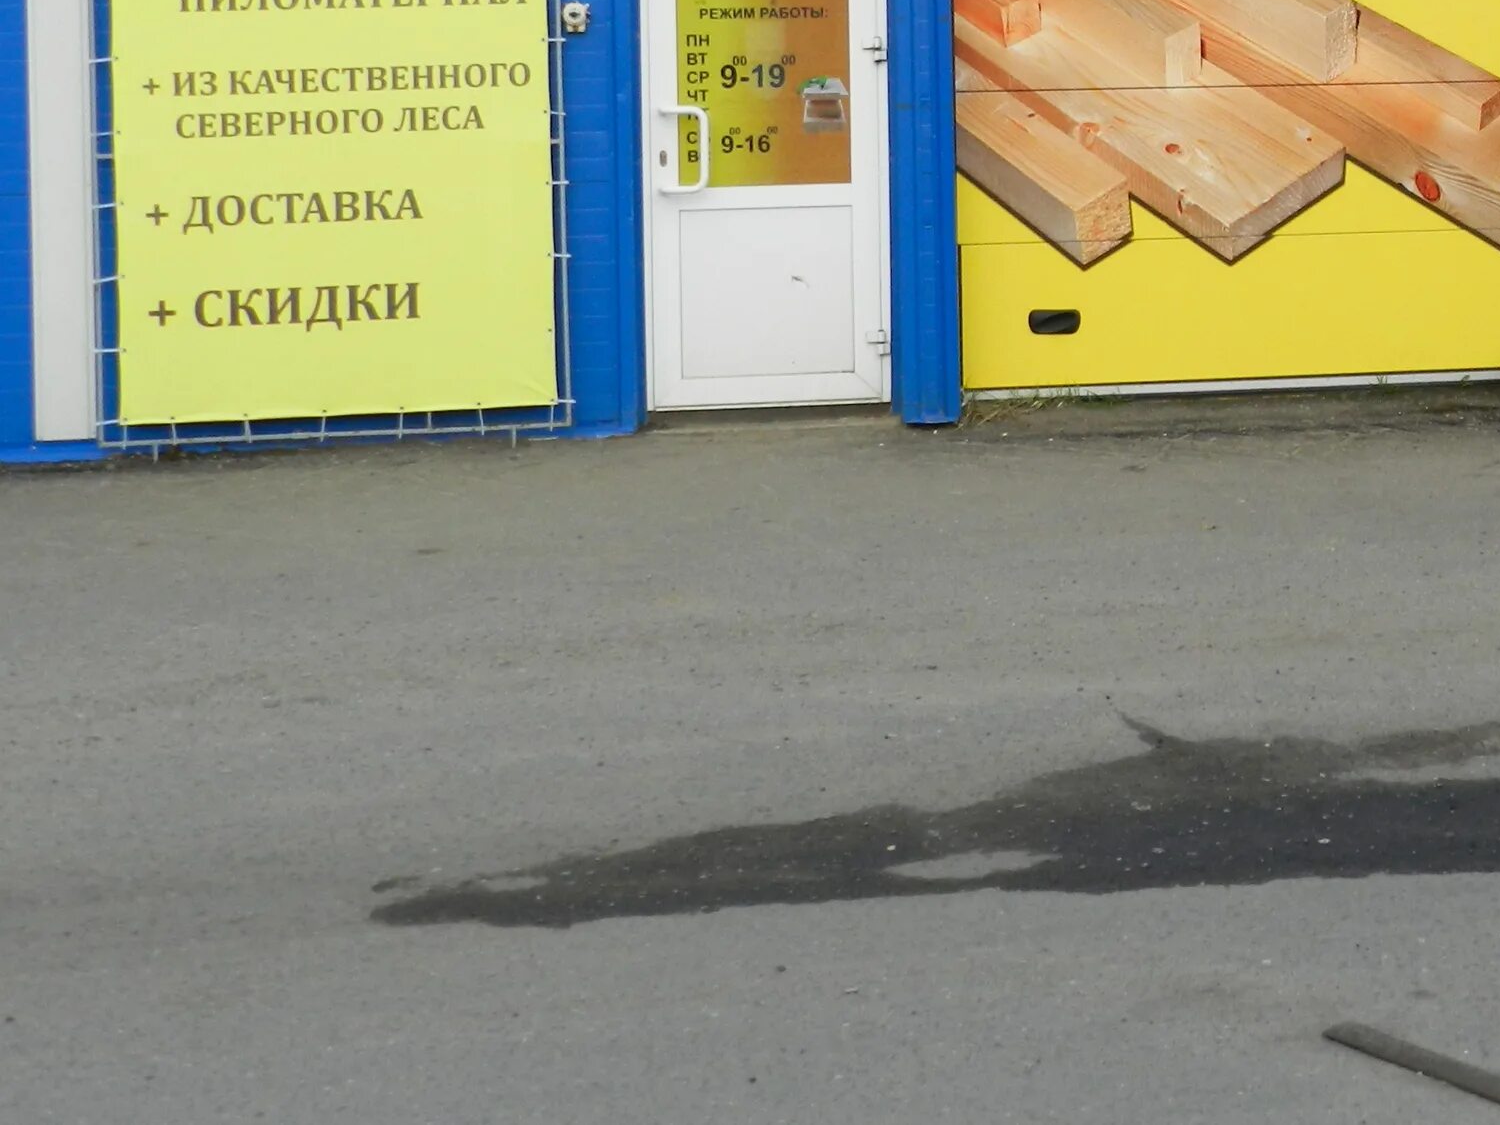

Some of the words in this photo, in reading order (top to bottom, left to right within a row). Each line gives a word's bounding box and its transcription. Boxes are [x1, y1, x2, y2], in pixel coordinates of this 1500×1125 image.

[700, 7, 756, 20] РЕЖИМ
[686, 35, 710, 47] ПН
[686, 53, 708, 65] ВТ
[172, 70, 218, 98] ИЗ
[229, 62, 532, 96] КАЧЕСТВЕННОГО
[686, 71, 710, 84] СР
[687, 89, 709, 102] ЧТ
[175, 107, 384, 139] СЕВЕРНОГО
[393, 105, 485, 133] ЛЕСА
[182, 188, 424, 235] ДОСТАВКА
[194, 282, 421, 332] СКИДКИ
